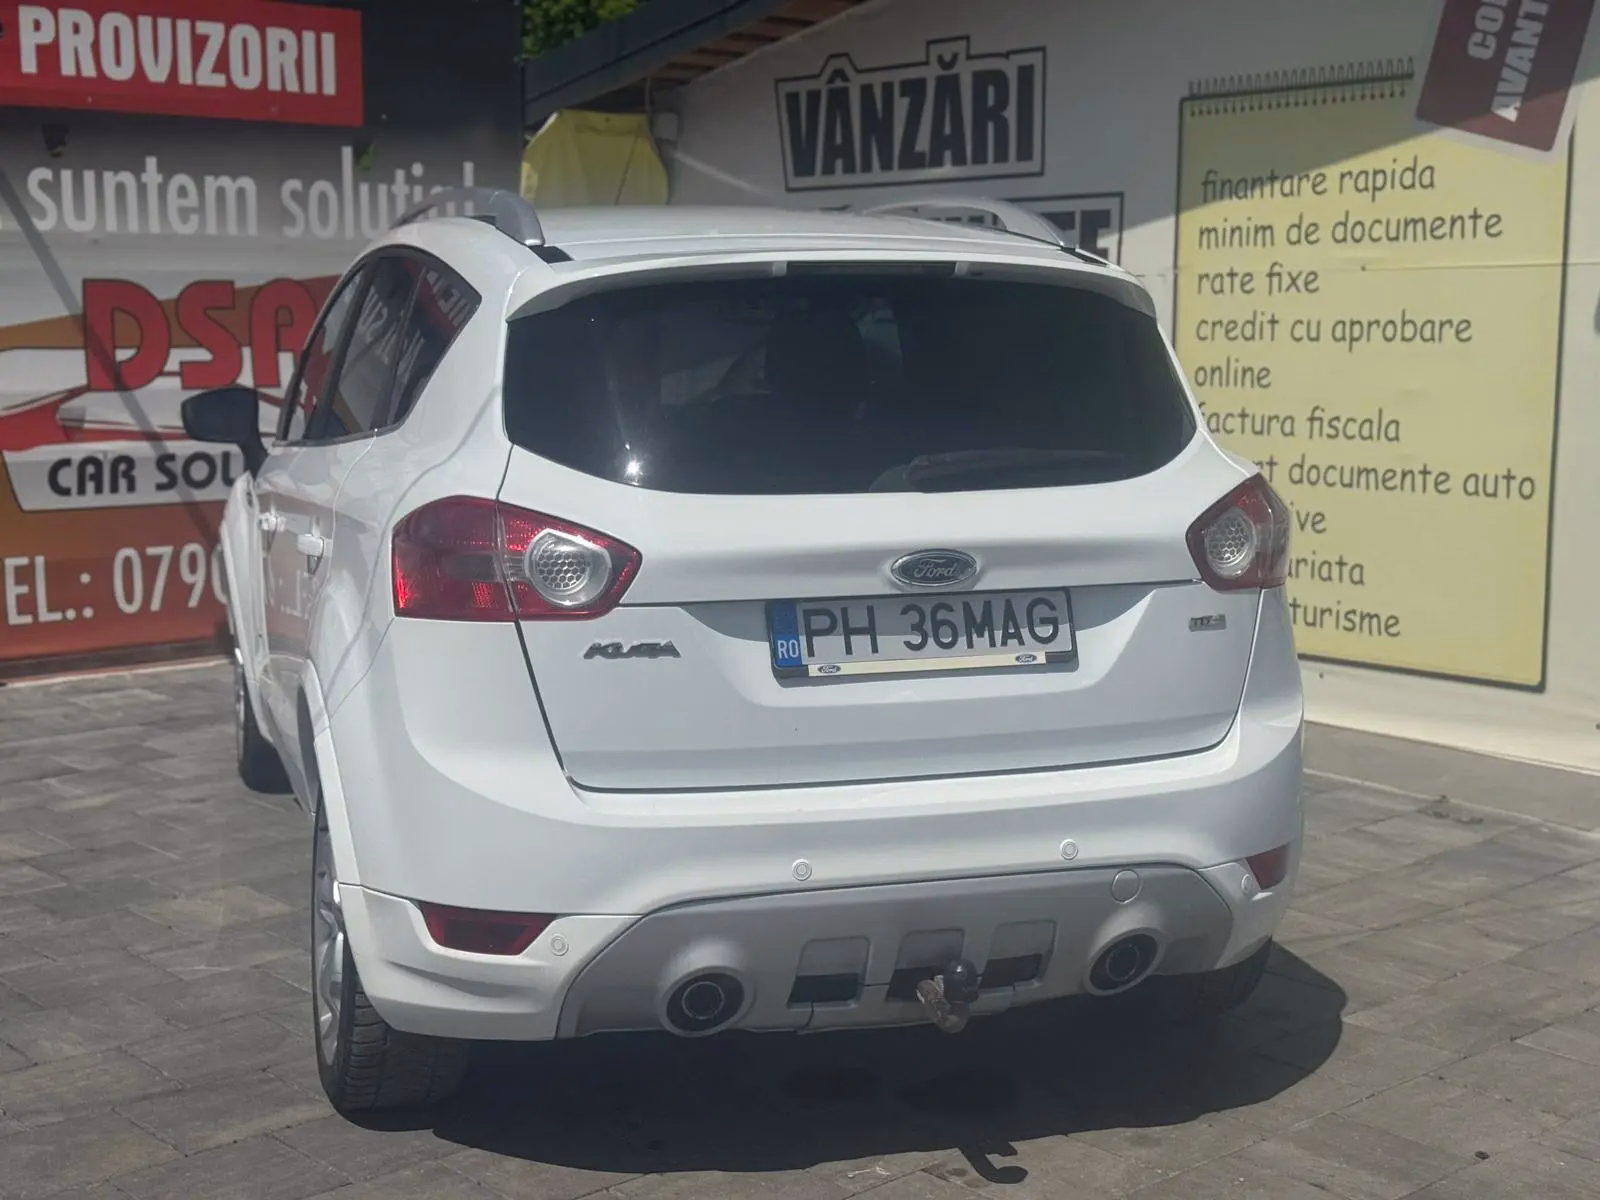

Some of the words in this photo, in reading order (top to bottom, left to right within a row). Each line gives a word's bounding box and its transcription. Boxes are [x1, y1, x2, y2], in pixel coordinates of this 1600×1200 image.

[17, 4, 337, 96] PROVIZORII
[1467, 0, 1508, 60] CO
[785, 52, 1035, 178] VÂNZĂRI
[26, 155, 258, 237] suntem
[1200, 169, 1328, 204] finantare
[1338, 155, 1436, 203] rapida
[1198, 216, 1275, 251] minim
[1286, 212, 1321, 246] de
[1331, 206, 1504, 244] documente
[1197, 266, 1256, 296] rate
[1266, 261, 1320, 297] fixe
[82, 278, 320, 392] DSA
[1195, 310, 1280, 343] credit
[1290, 319, 1322, 344] cu
[1331, 309, 1473, 353] aprobare
[1193, 356, 1272, 390] online
[1306, 405, 1401, 442] fiscala
[47, 452, 137, 497] CAR
[154, 450, 237, 491] SOL
[1288, 453, 1452, 495] documente
[1463, 467, 1536, 501] auto
[912, 557, 960, 579] Ford
[802, 604, 879, 658] PH
[900, 596, 1060, 651] 36MAG
[1288, 597, 1401, 638] turisme
[777, 639, 800, 660] RO
